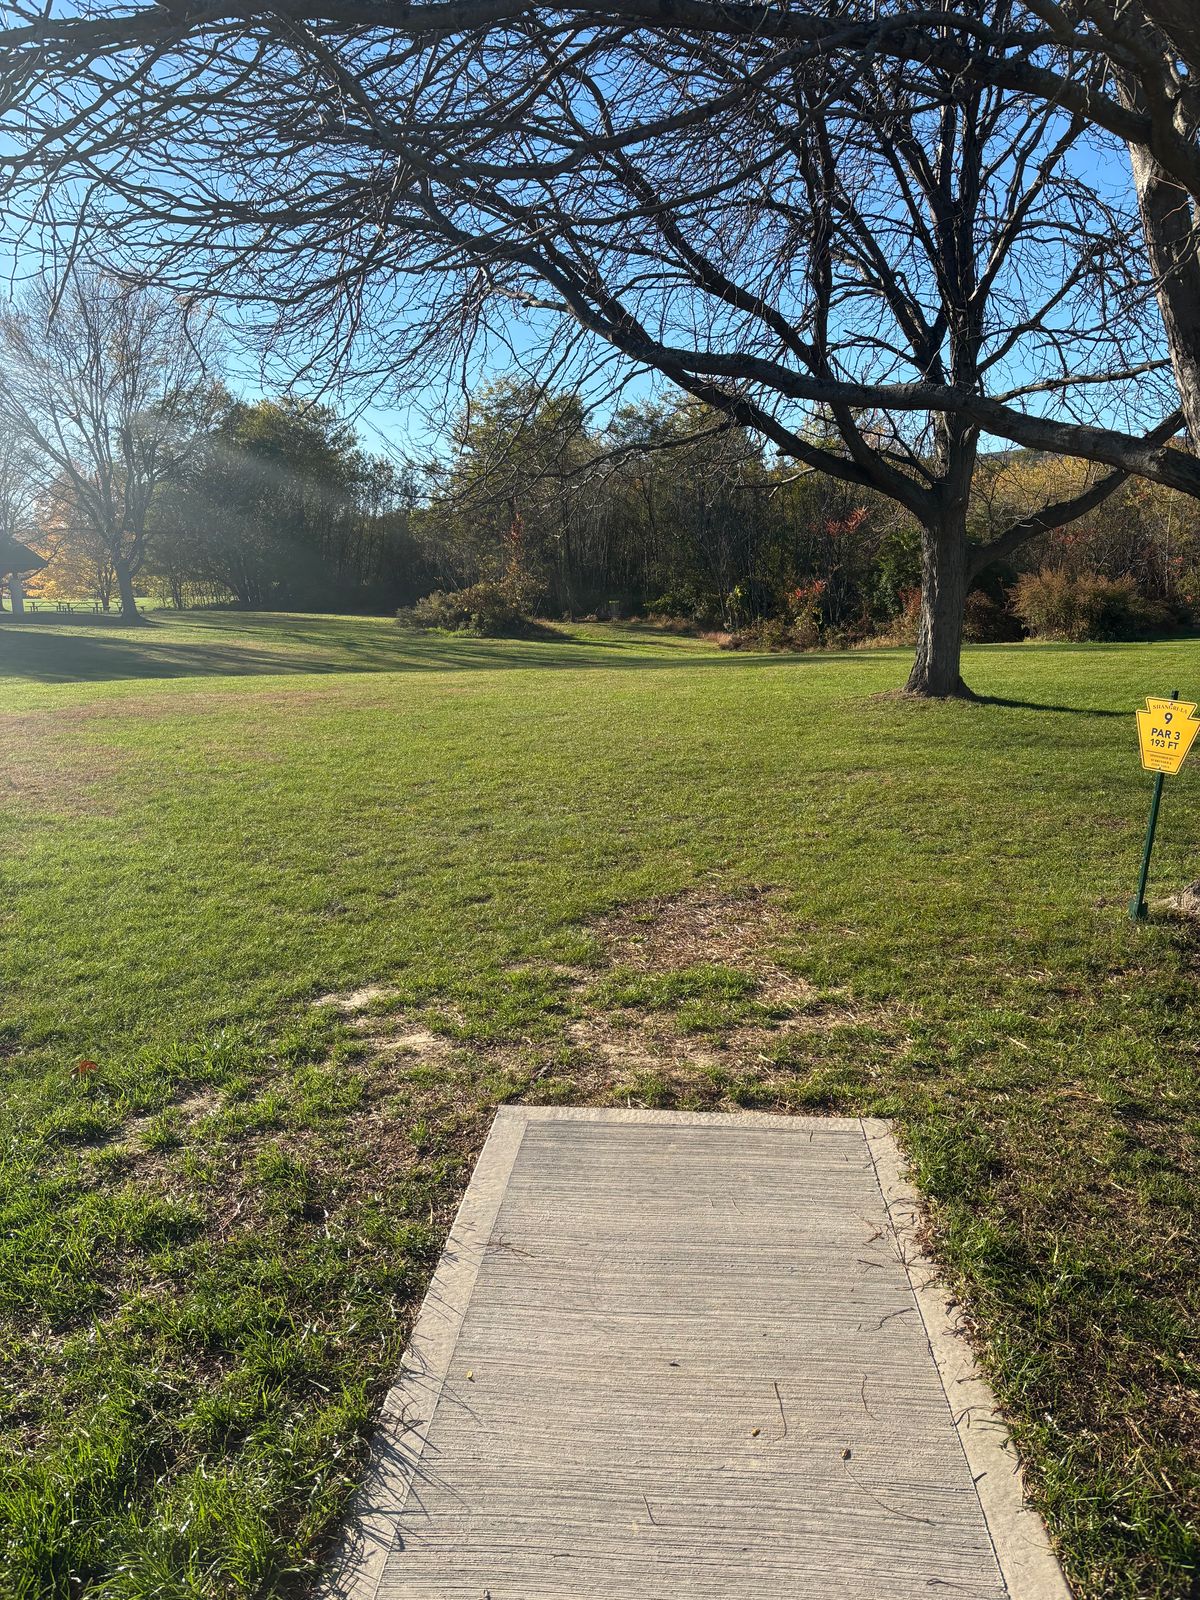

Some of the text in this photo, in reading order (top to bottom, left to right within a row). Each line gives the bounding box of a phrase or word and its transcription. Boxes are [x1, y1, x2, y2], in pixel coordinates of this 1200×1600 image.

[1152, 704, 1188, 714] SHANGRI-LA
[1164, 712, 1173, 724] 9
[1151, 727, 1181, 740] PAR 3
[1150, 738, 1179, 750] 193 FT
